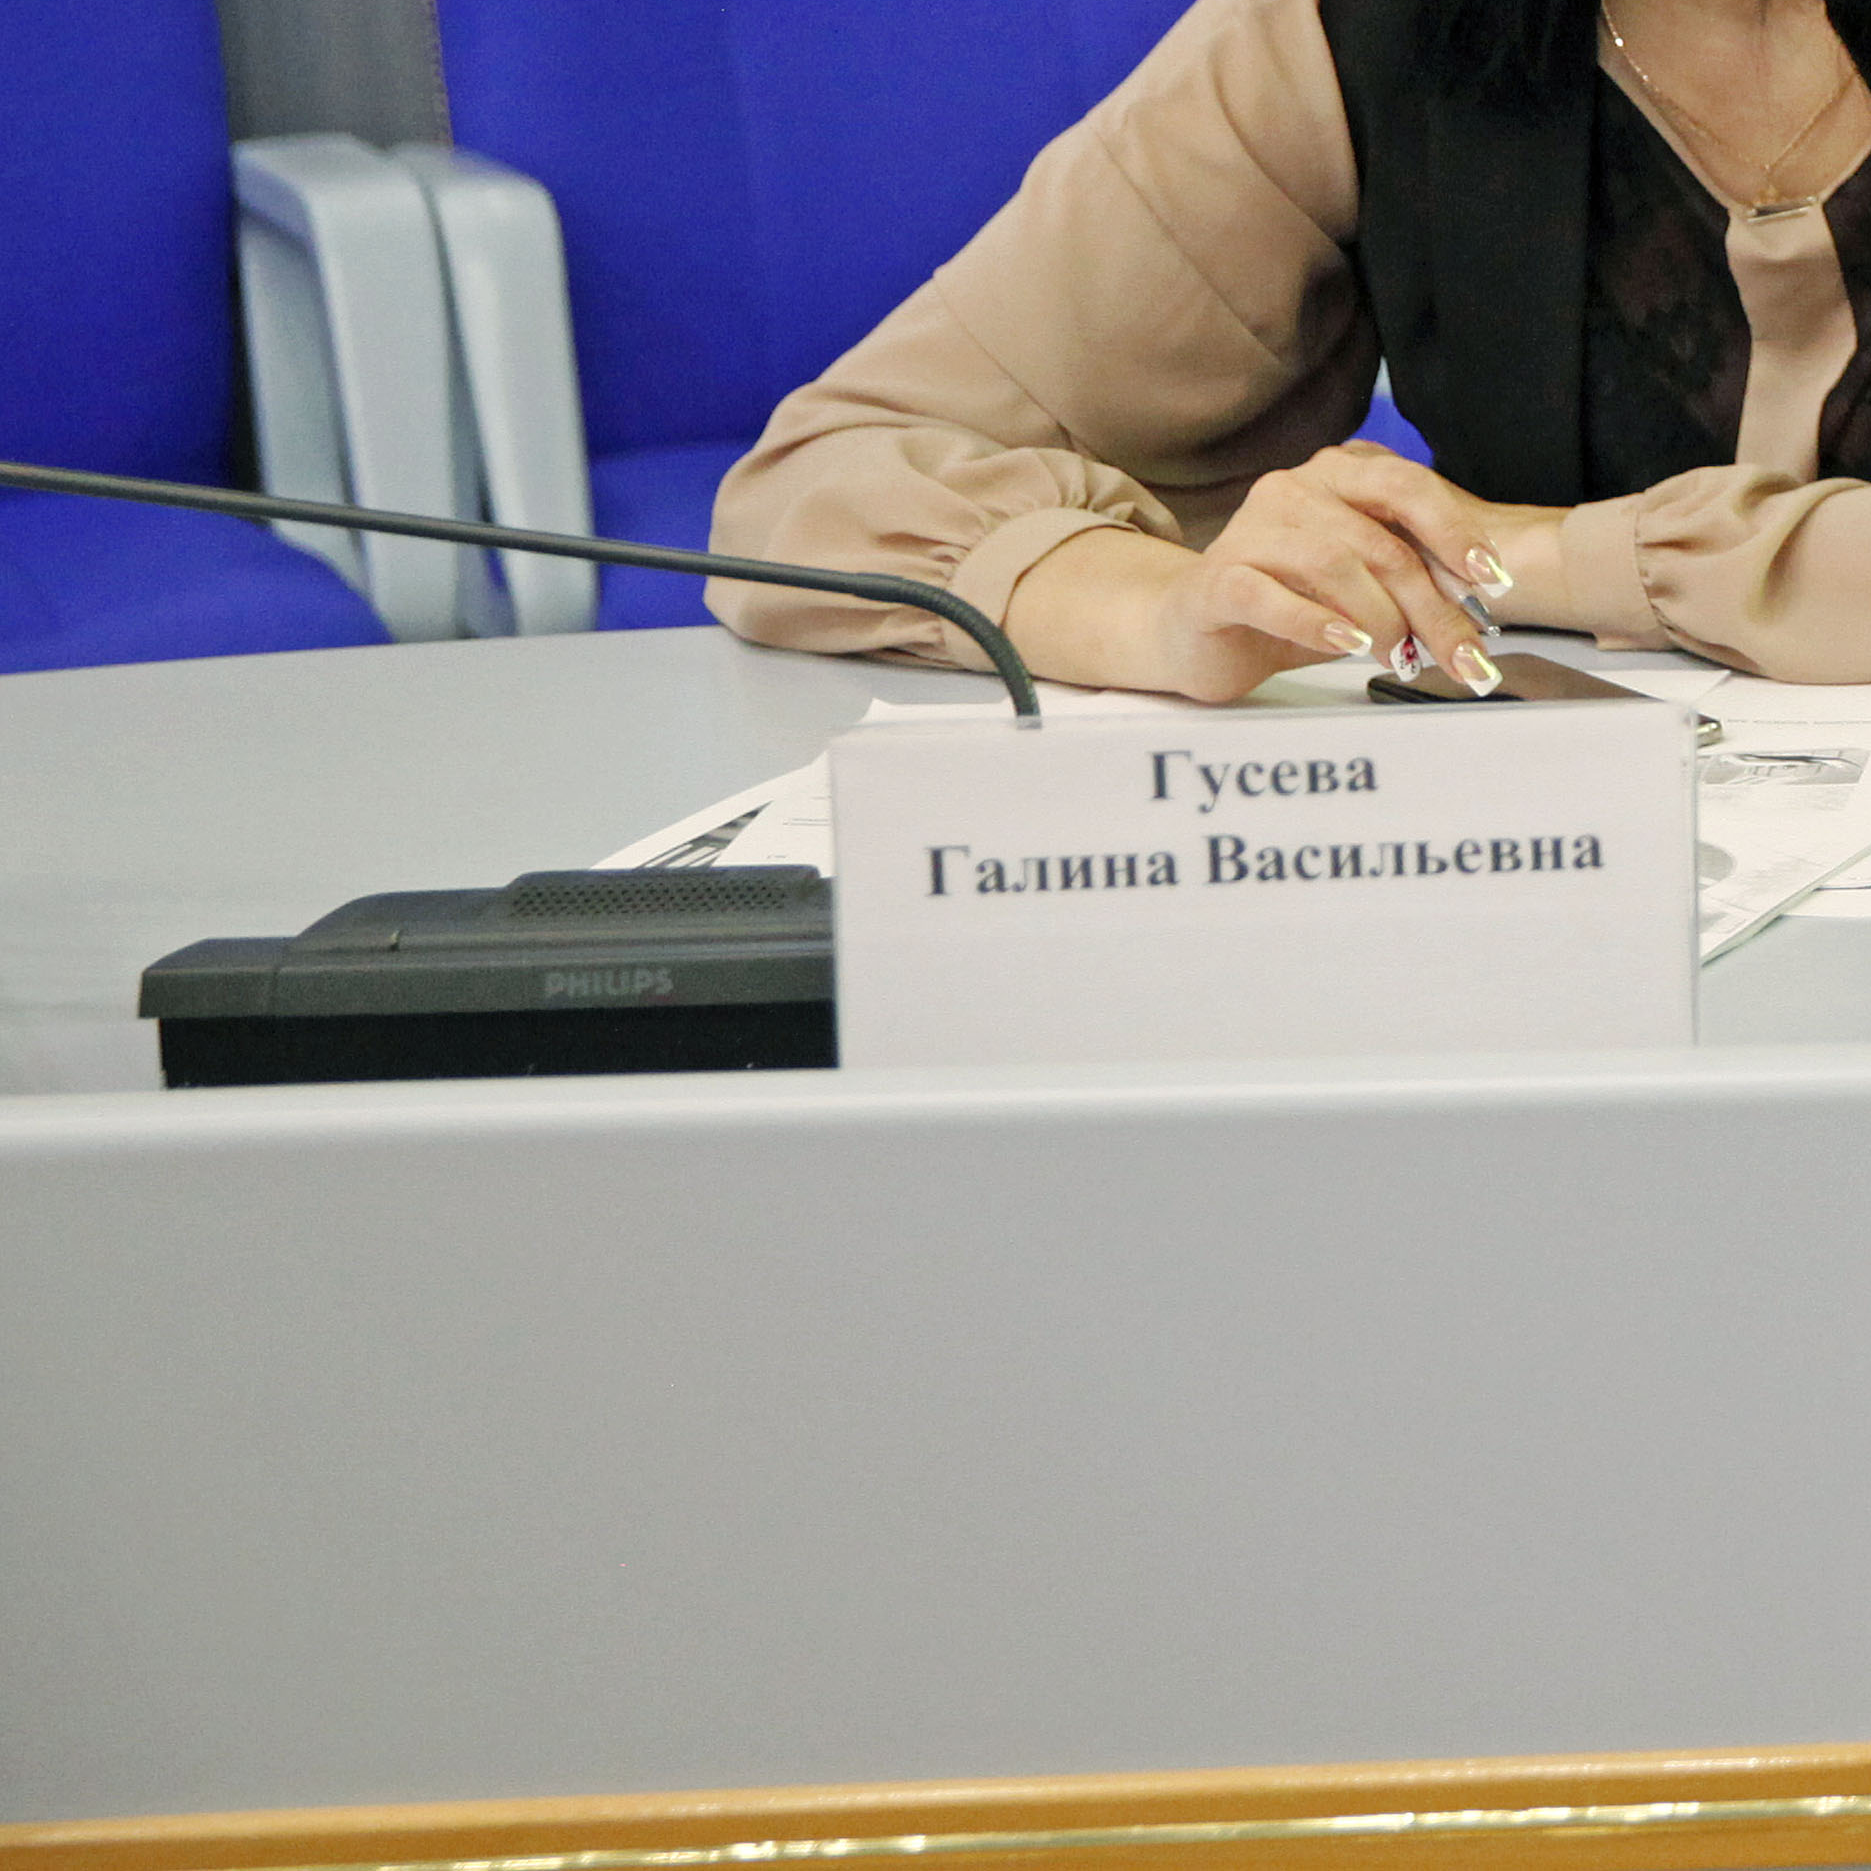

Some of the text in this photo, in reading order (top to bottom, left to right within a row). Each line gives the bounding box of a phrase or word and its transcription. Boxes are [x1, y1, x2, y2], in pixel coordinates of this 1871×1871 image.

[1151, 751, 1378, 814] Гусева
[928, 835, 1604, 897] Галина Васильевна
[545, 968, 674, 998] PHILIPS
